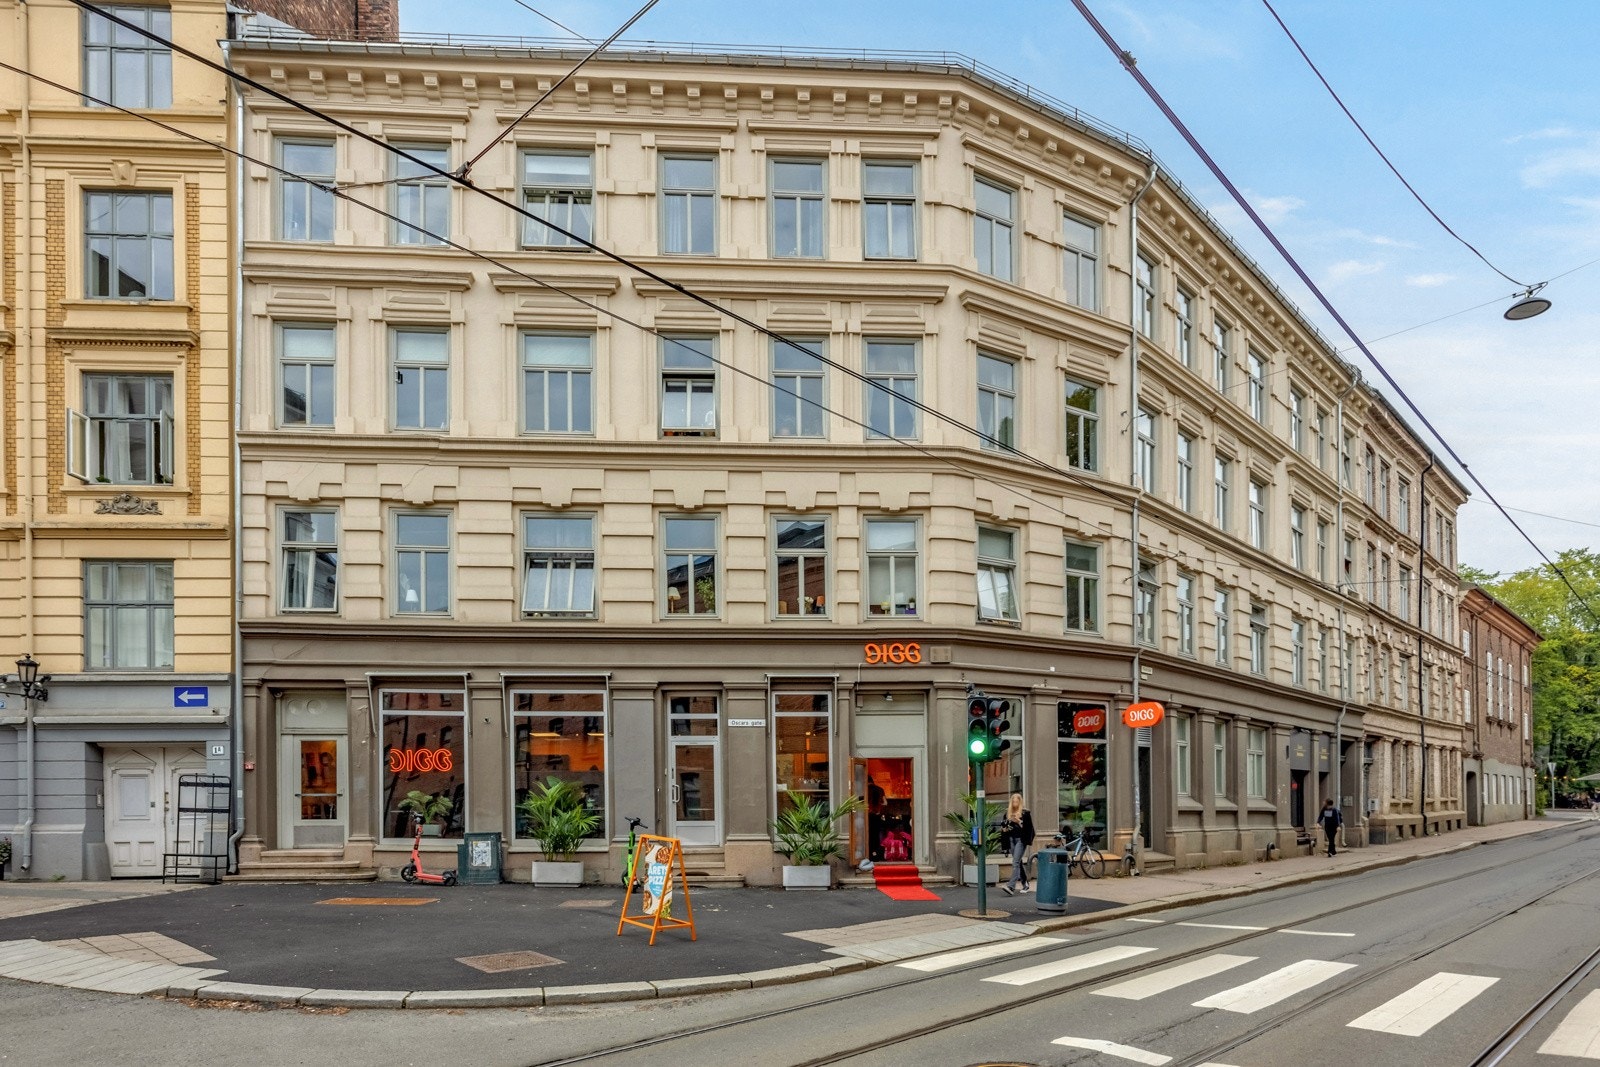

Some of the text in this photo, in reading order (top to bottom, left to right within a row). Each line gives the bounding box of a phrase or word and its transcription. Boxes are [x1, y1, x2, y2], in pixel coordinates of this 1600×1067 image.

[864, 642, 922, 664] DIGG
[1129, 708, 1154, 722] DIGG
[390, 748, 453, 772] DIGG
[648, 875, 665, 885] PIZZ
